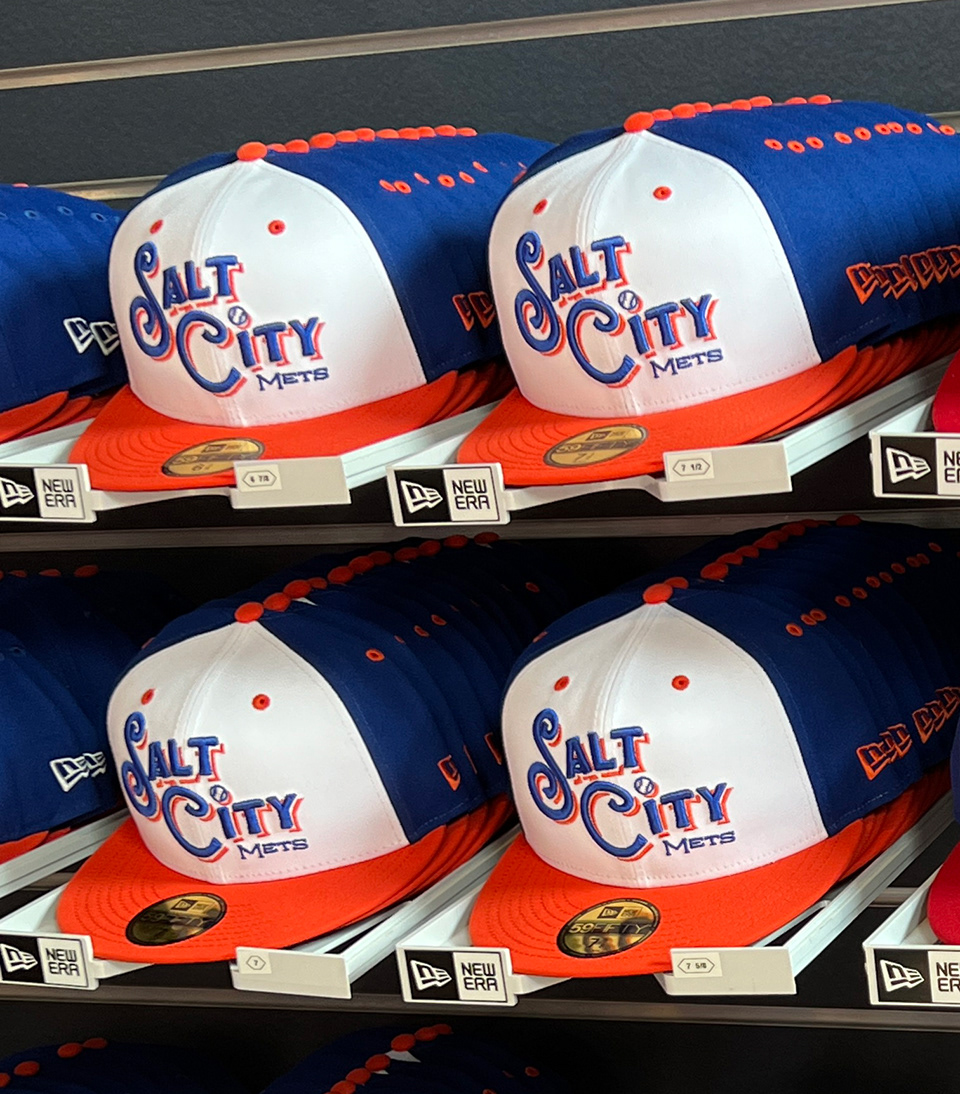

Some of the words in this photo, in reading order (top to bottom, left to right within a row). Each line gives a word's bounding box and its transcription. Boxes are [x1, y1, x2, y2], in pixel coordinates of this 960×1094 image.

[42, 479, 74, 492] NEW
[452, 479, 488, 495] NEW
[45, 494, 76, 508] ERA
[454, 495, 490, 510] ERA
[45, 948, 78, 963] NEW
[48, 962, 80, 977] ERA
[461, 962, 496, 976] NEW
[463, 977, 499, 991] ERA
